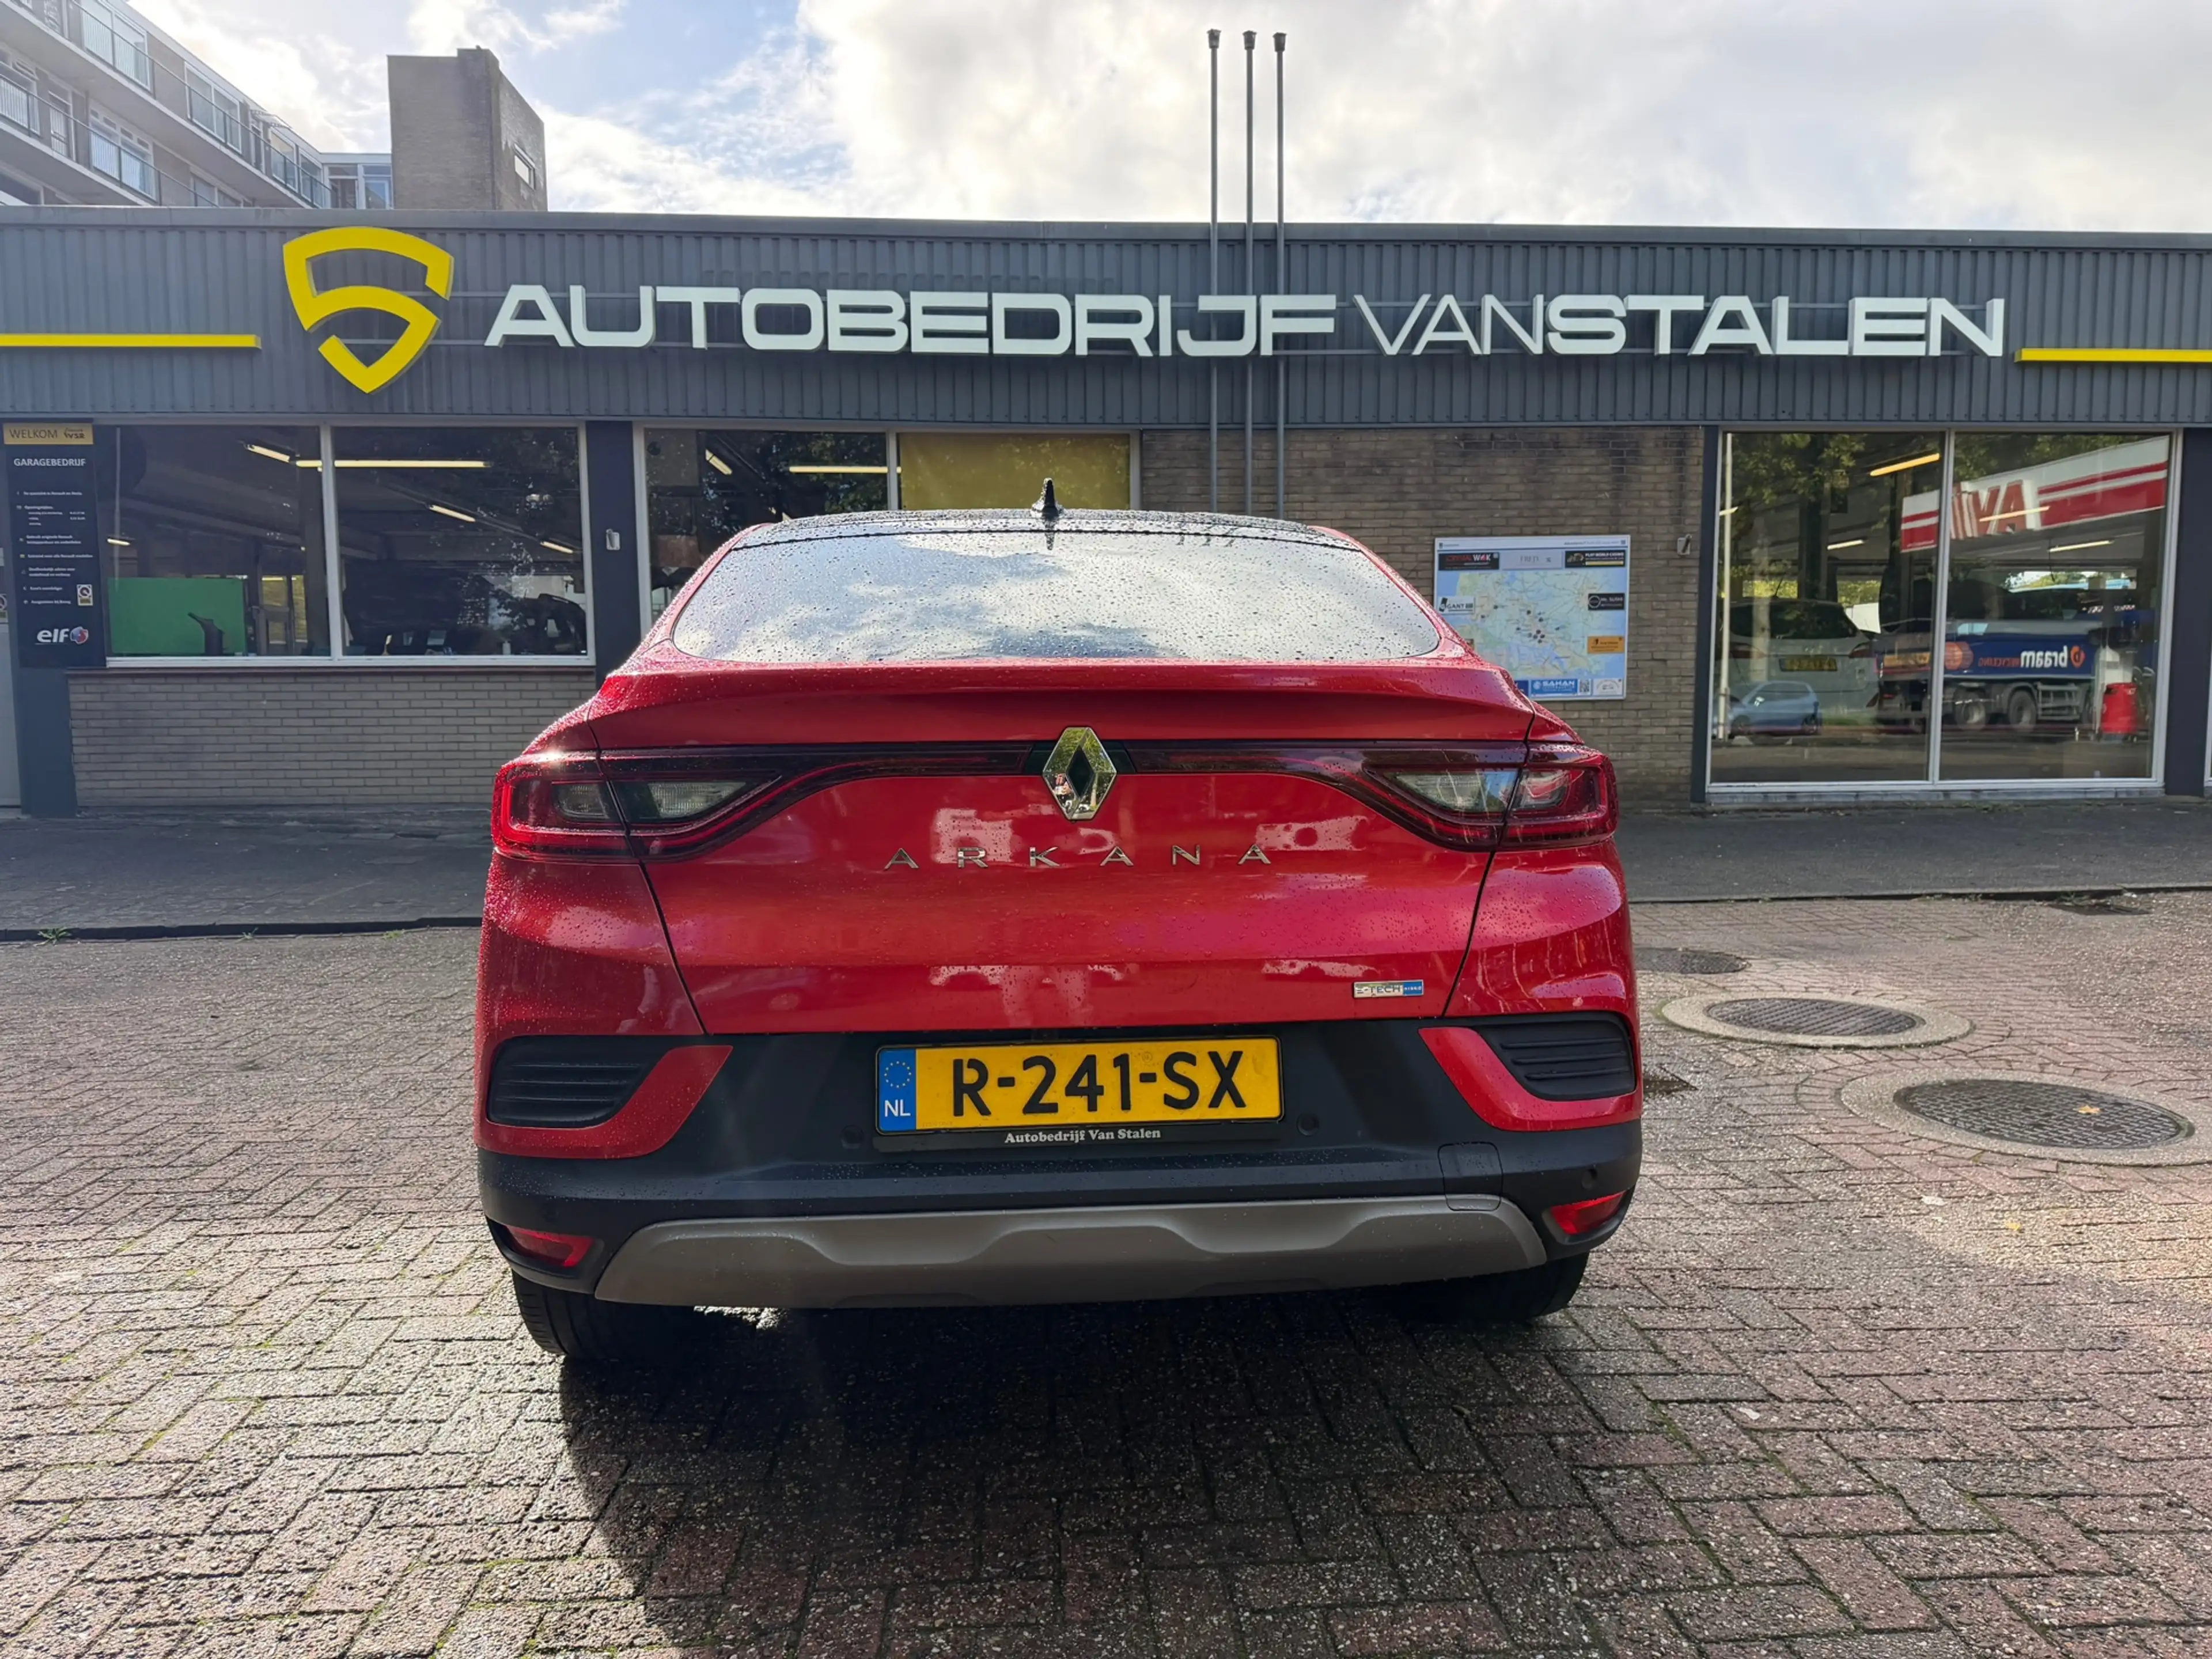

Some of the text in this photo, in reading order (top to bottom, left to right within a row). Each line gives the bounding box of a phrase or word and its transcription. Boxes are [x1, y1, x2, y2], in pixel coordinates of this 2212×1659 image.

[484, 283, 1336, 358] AUTOBEDRIJF
[9, 429, 58, 439] WELKOM
[13, 458, 86, 467] GARAGEBEDRIJF
[36, 628, 69, 643] elf
[884, 843, 1272, 870] ARKANA
[884, 1050, 1247, 1118] NL R-241-SX
[1004, 1127, 1161, 1144] Autobedrijf Van Stalen
